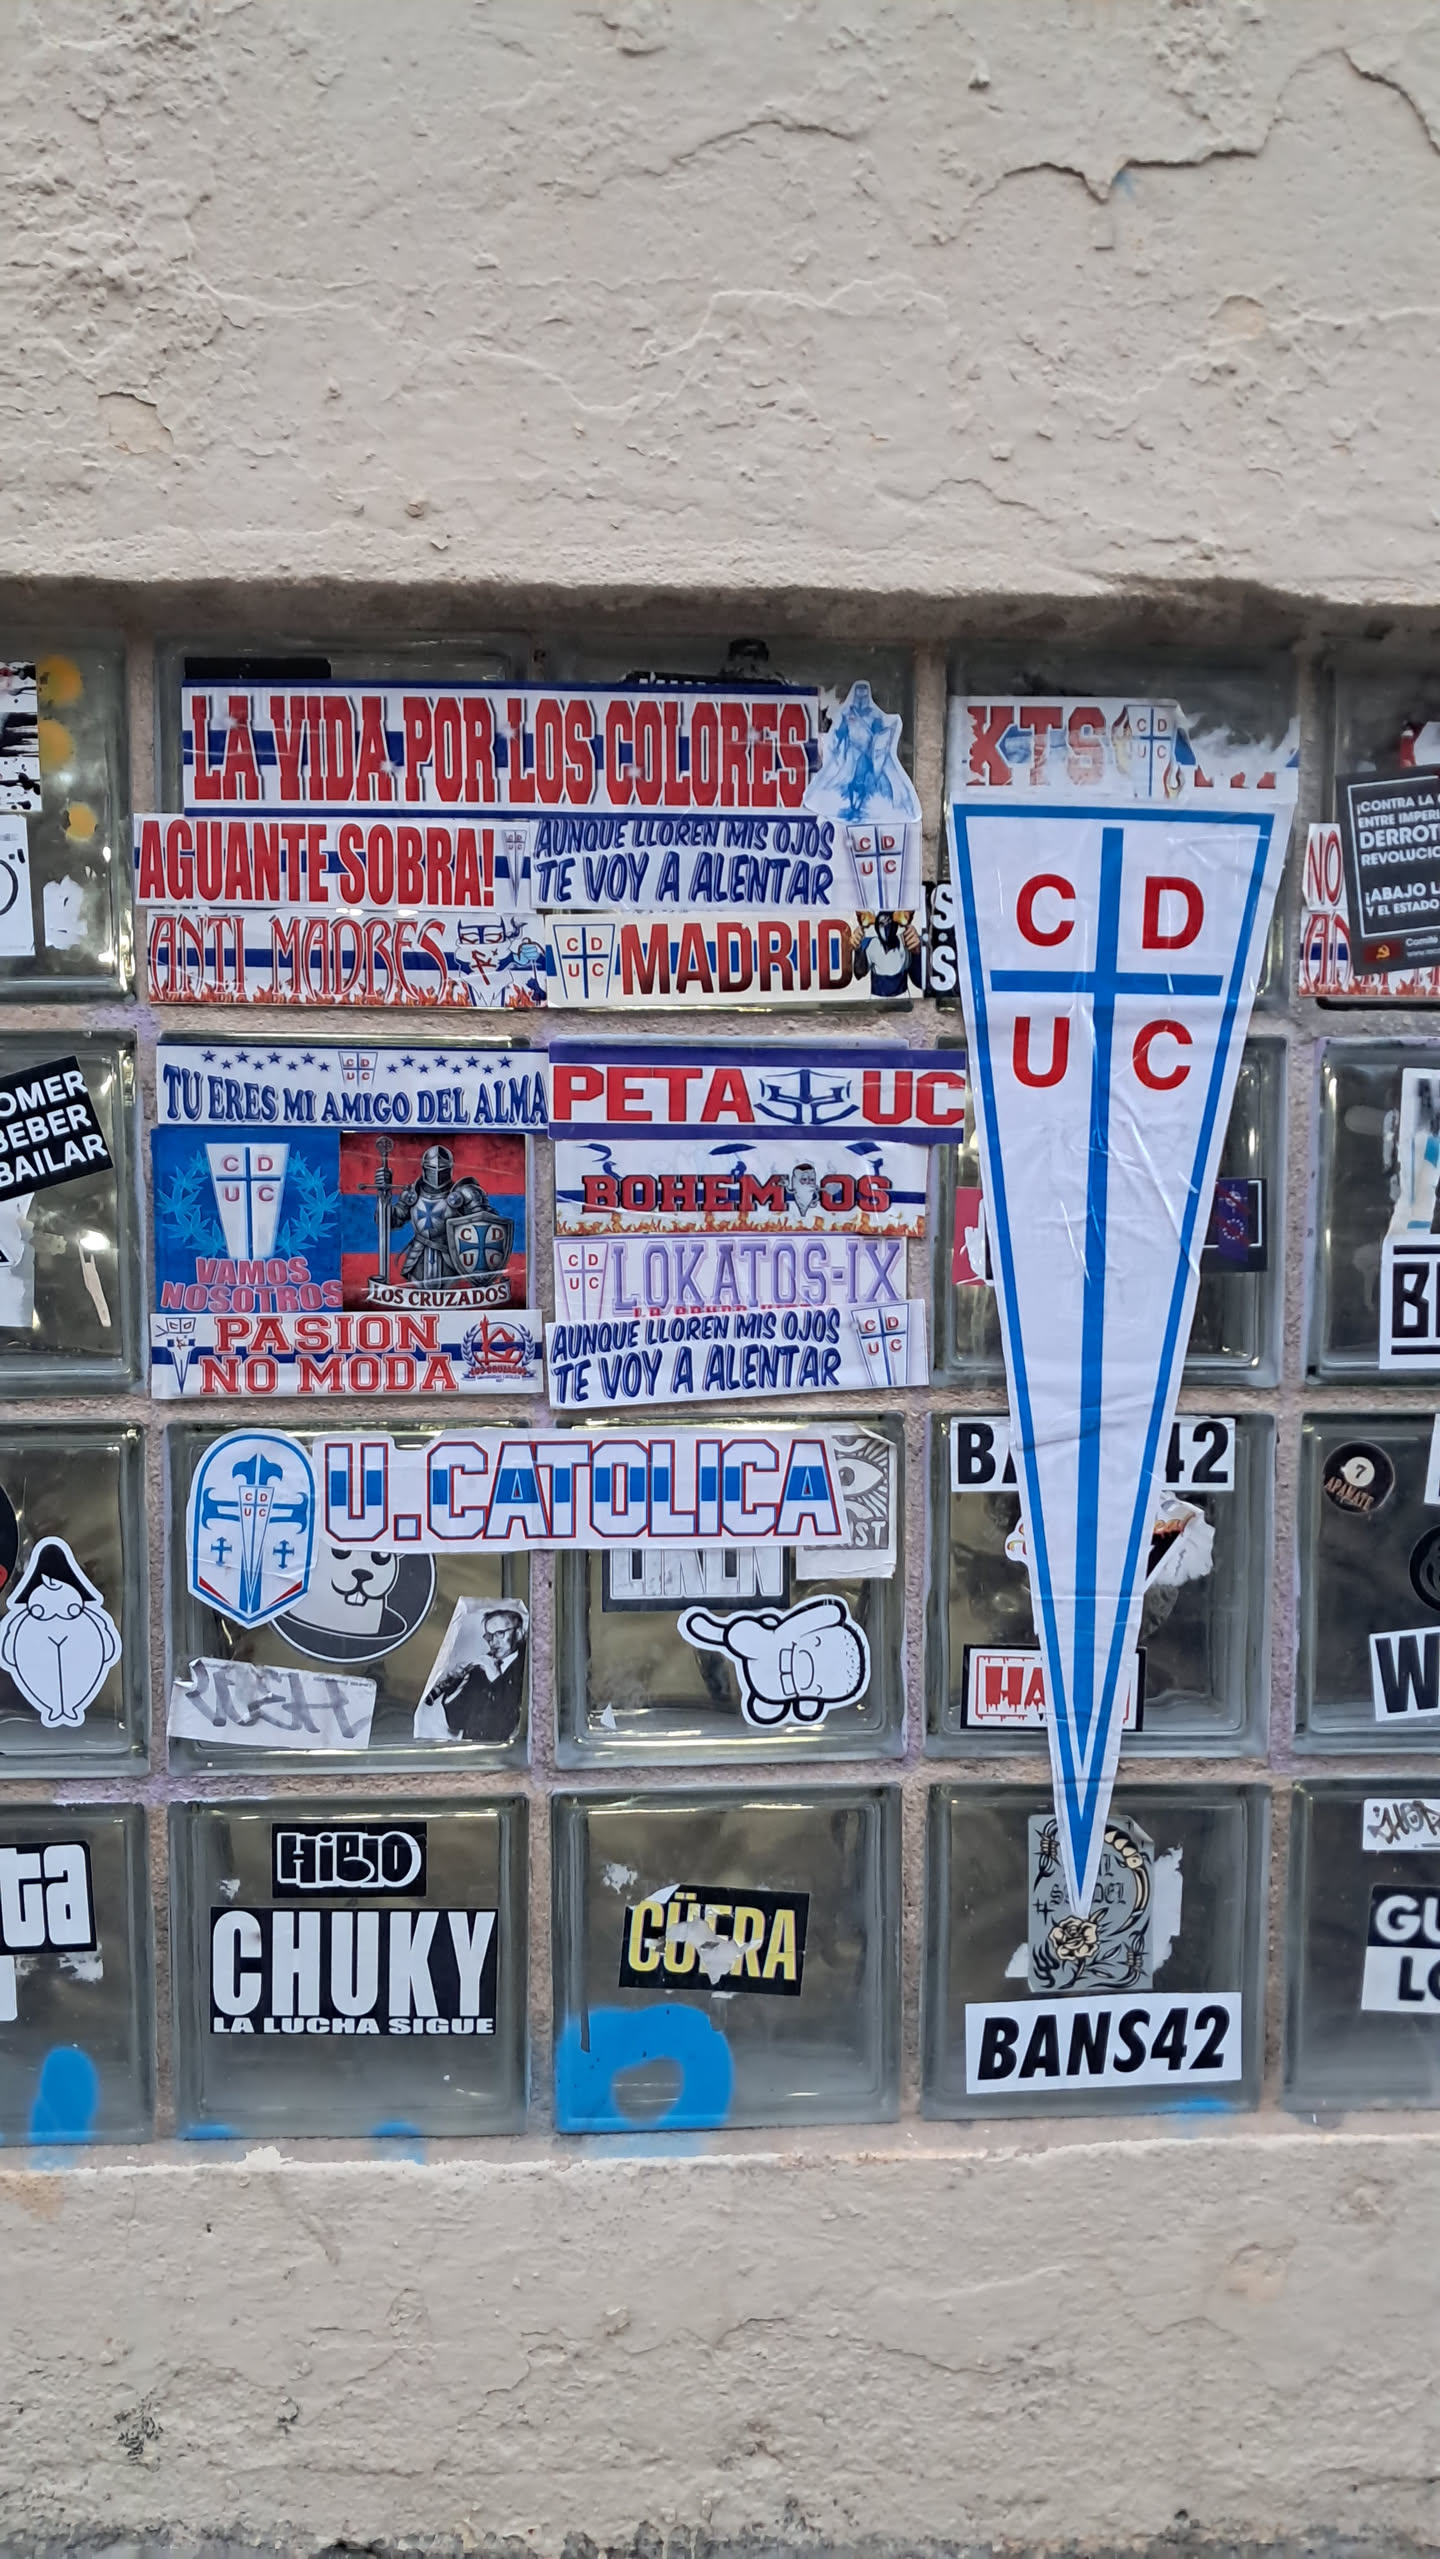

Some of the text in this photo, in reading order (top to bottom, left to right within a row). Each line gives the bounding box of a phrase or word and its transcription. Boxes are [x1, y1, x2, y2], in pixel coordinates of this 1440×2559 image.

[192, 696, 807, 808] LA VIDA POR LOS COLORES
[966, 705, 1107, 786] KTS
[1418, 793, 1435, 807] LA
[535, 820, 836, 861] AUNQUE LLOREN MIS OJOS
[1358, 813, 1396, 829] ENTRE
[138, 819, 495, 907] AGUANTE SOBRA!
[860, 835, 896, 851] C D
[535, 851, 836, 906] TE VOY A ALENTAR
[862, 859, 898, 876] U C
[1307, 831, 1343, 906] NO
[1015, 873, 1205, 950] C D
[1366, 898, 1440, 917] Y EL ESTADO
[150, 915, 448, 1000] ANTI MADRES
[566, 936, 603, 952] C D
[620, 919, 855, 996] MADRID
[568, 963, 604, 978] U C
[1012, 1017, 1194, 1091] U C
[163, 1064, 549, 1125] TU ERES MI AMIGO DEL ALMA
[552, 1065, 967, 1126] PETA UC
[0, 1133, 108, 1188] BAILAR
[223, 1156, 274, 1173] C D
[224, 1186, 275, 1202] U C
[460, 1227, 504, 1241] C D
[195, 1256, 311, 1287] VAMOS
[462, 1252, 501, 1267] U C
[568, 1253, 599, 1268] C D
[610, 1239, 903, 1317] LOKATOS-IX
[161, 1280, 343, 1314] NOSOTROS
[372, 1282, 508, 1307] LOS CRUZADOS
[569, 1276, 600, 1291] U C
[214, 1314, 441, 1354] PASION
[552, 1319, 641, 1364] AUNQUE
[646, 1314, 729, 1345] LLOREN
[734, 1311, 777, 1341] MIS
[784, 1307, 841, 1346] OJOS
[864, 1316, 900, 1333] C D
[867, 1338, 902, 1356] U C
[199, 1354, 459, 1395] NO MODA
[553, 1345, 842, 1405] TE VOY A ALENTAR
[324, 1439, 842, 1542] U.CATOLICA
[1356, 1464, 1368, 1479] 7
[212, 1910, 496, 2017] CHUKY
[213, 2017, 494, 2035] LA LUCHA SIGUE
[977, 2004, 1231, 2081] BANS42
